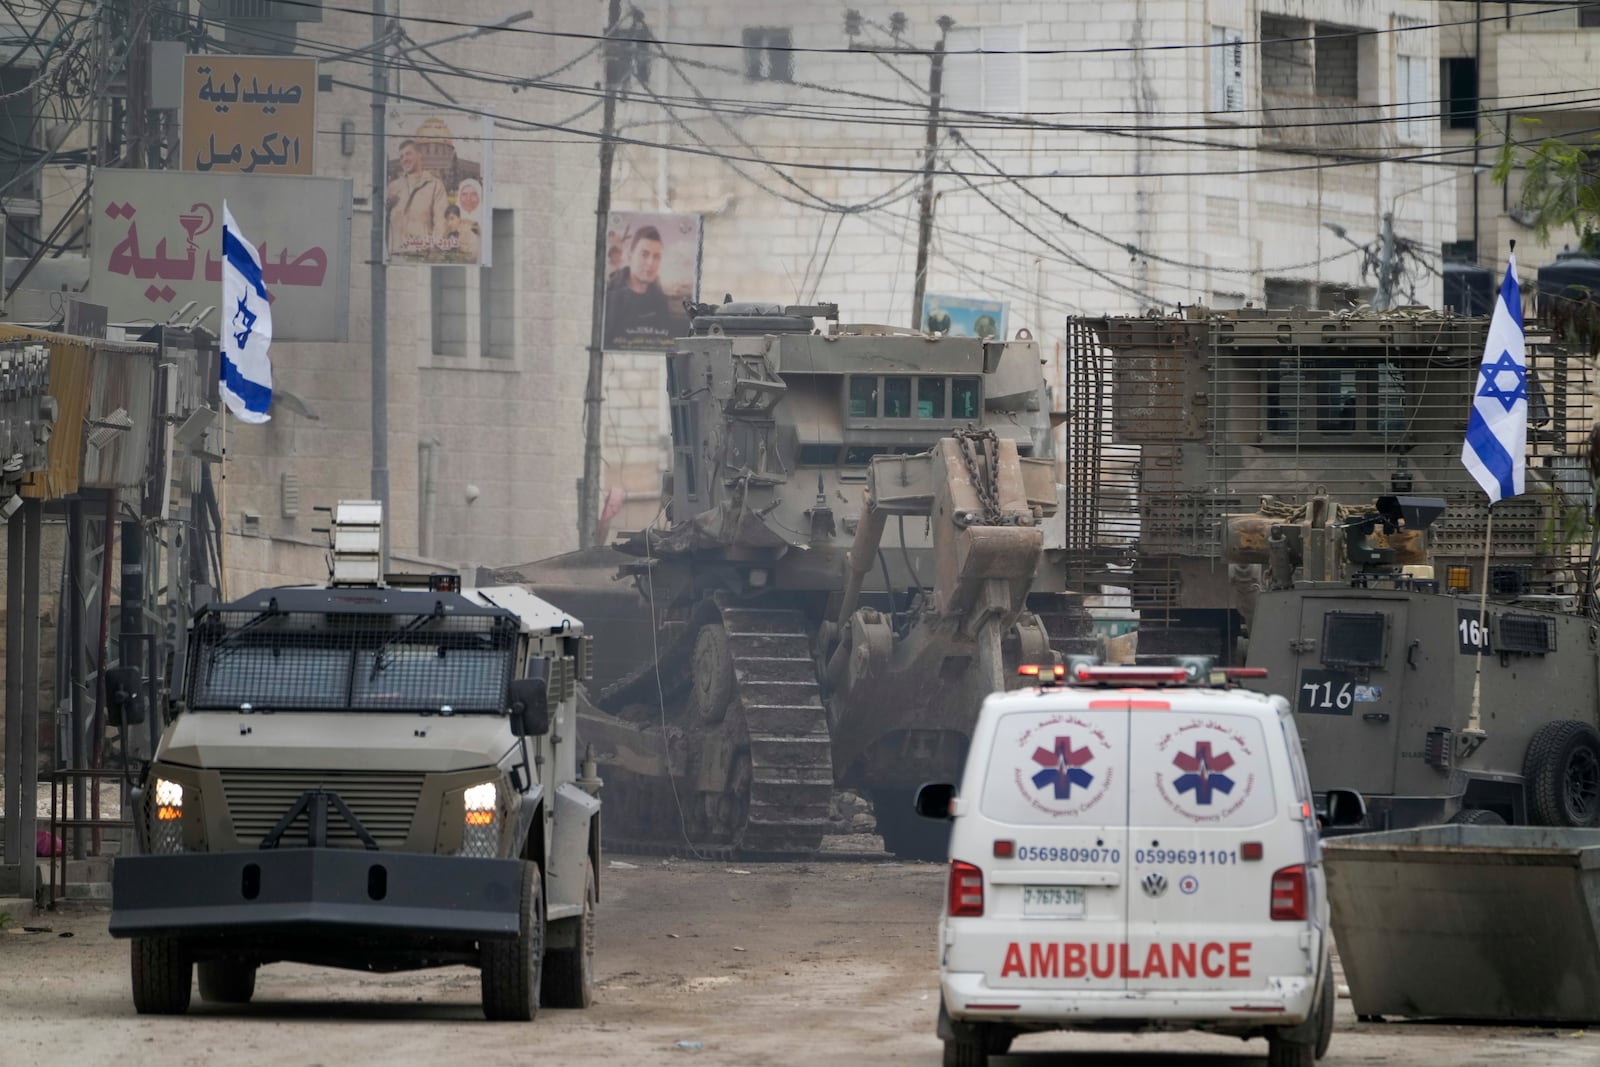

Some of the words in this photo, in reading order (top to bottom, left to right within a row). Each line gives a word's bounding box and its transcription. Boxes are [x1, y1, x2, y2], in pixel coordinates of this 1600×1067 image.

[197, 66, 302, 114] صيدلية
[196, 132, 300, 173] الكرمل
[1032, 799, 1079, 818] Emergency
[1173, 804, 1220, 823] Emergency
[1018, 846, 1120, 864] 0569809070
[1135, 849, 1238, 865] 0599691101
[1000, 942, 1253, 978] AMBULANCE
